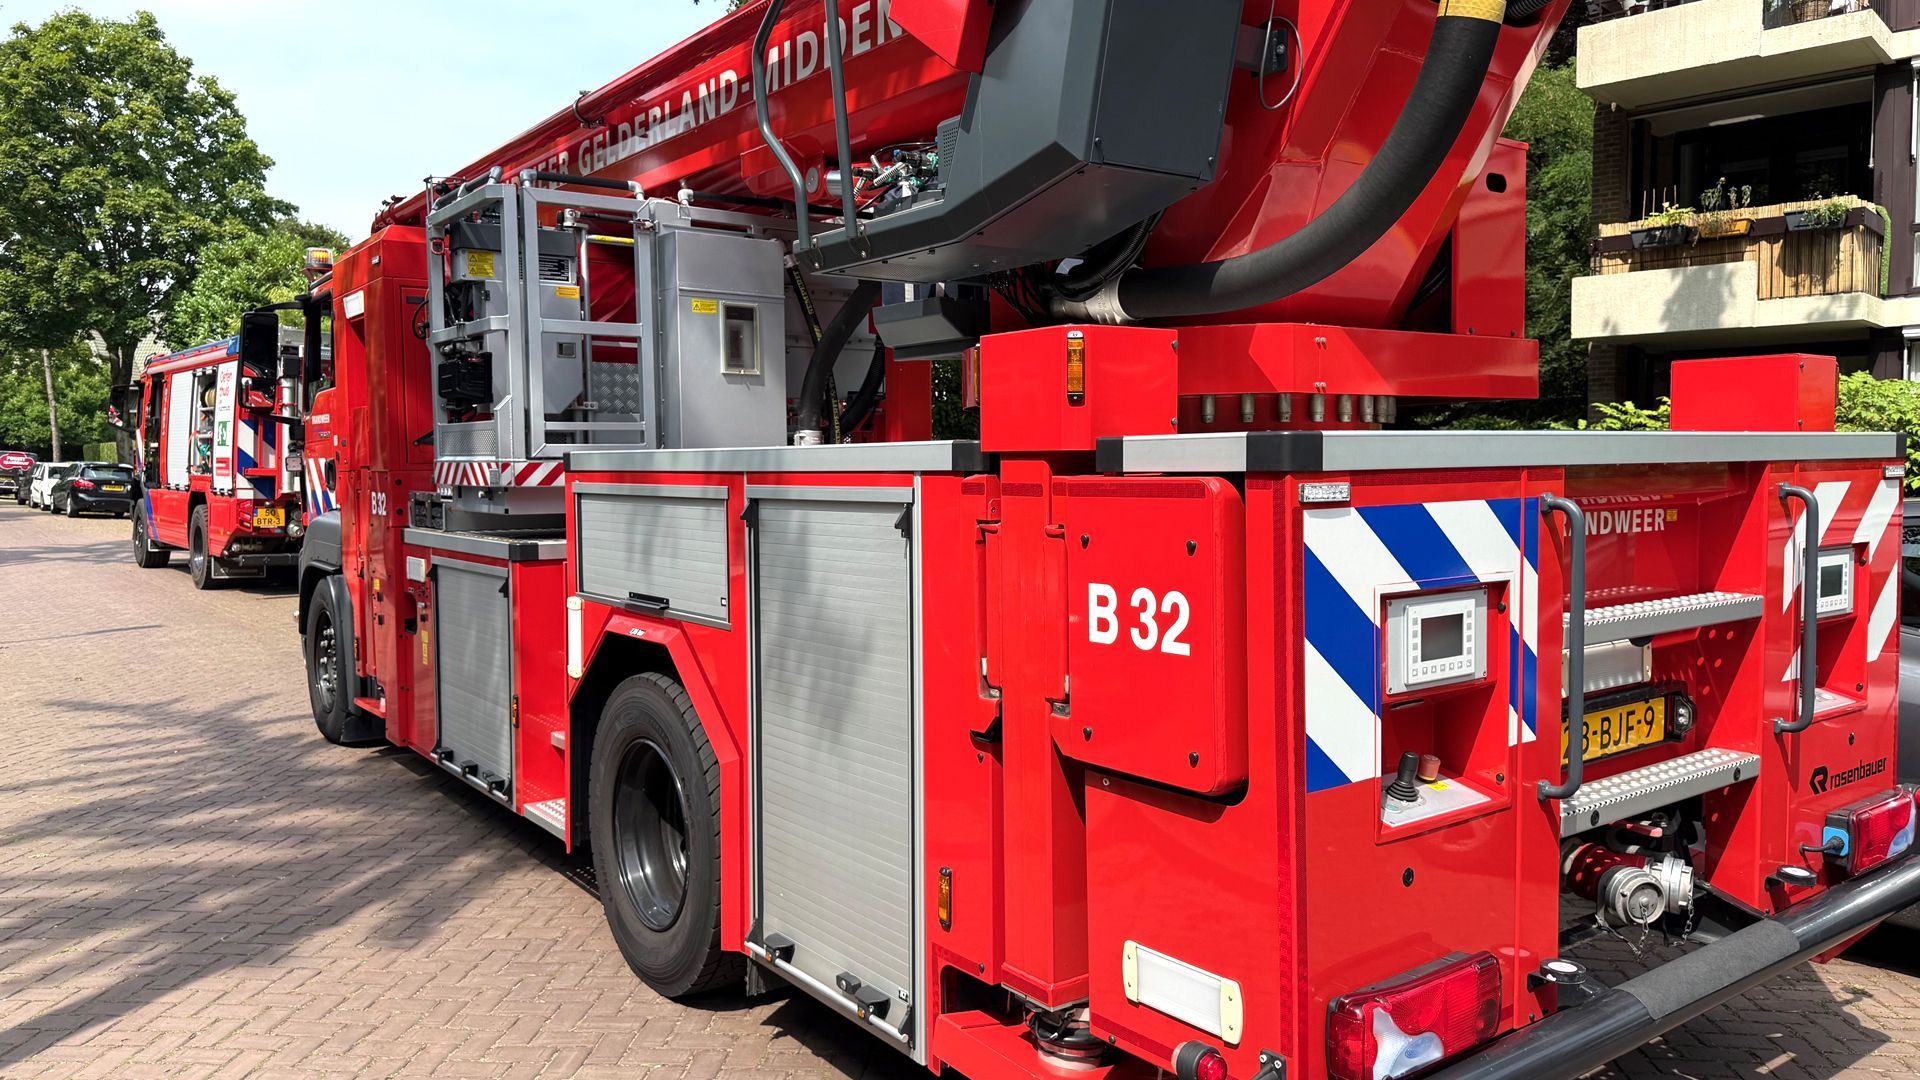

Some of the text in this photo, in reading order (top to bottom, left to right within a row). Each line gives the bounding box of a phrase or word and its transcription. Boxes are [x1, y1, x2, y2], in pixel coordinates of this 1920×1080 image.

[371, 491, 387, 516] B 32
[1564, 508, 1665, 537] NDWEER
[1088, 582, 1191, 657] B 32
[1830, 757, 1887, 790] rosenbauer
